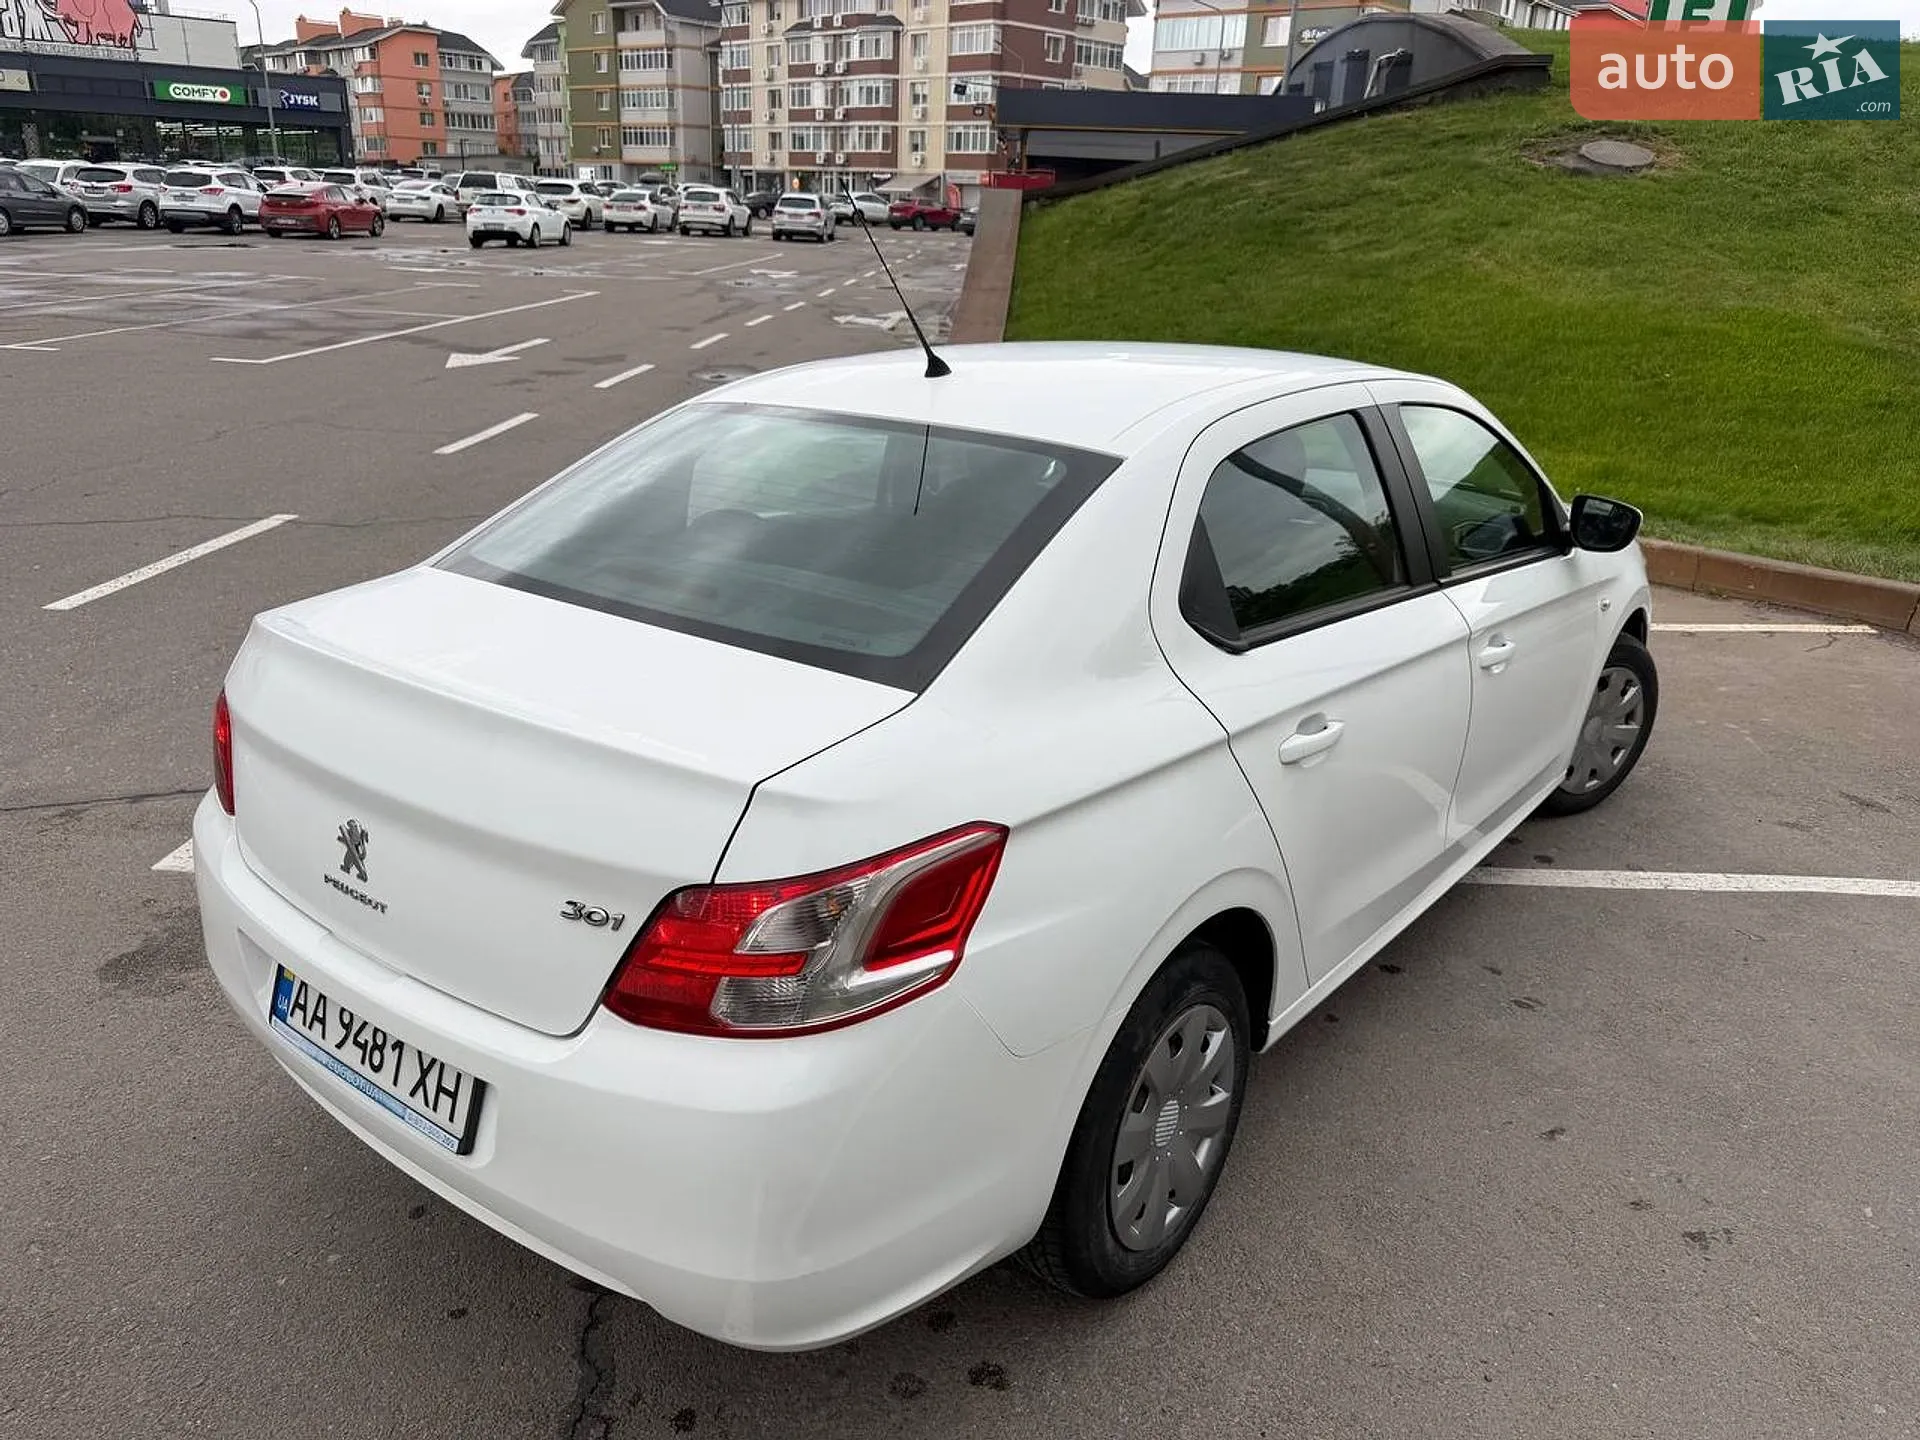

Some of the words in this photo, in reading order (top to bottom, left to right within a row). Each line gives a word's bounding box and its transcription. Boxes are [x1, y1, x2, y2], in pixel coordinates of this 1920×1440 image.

[172, 86, 218, 99] COMFY
[289, 94, 319, 107] JYSK
[323, 874, 388, 914] PEUGEOT
[560, 900, 625, 931] 301
[277, 995, 288, 1013] UA
[290, 980, 327, 1041] AA
[335, 1006, 404, 1087] 9481
[409, 1050, 462, 1123] XH
